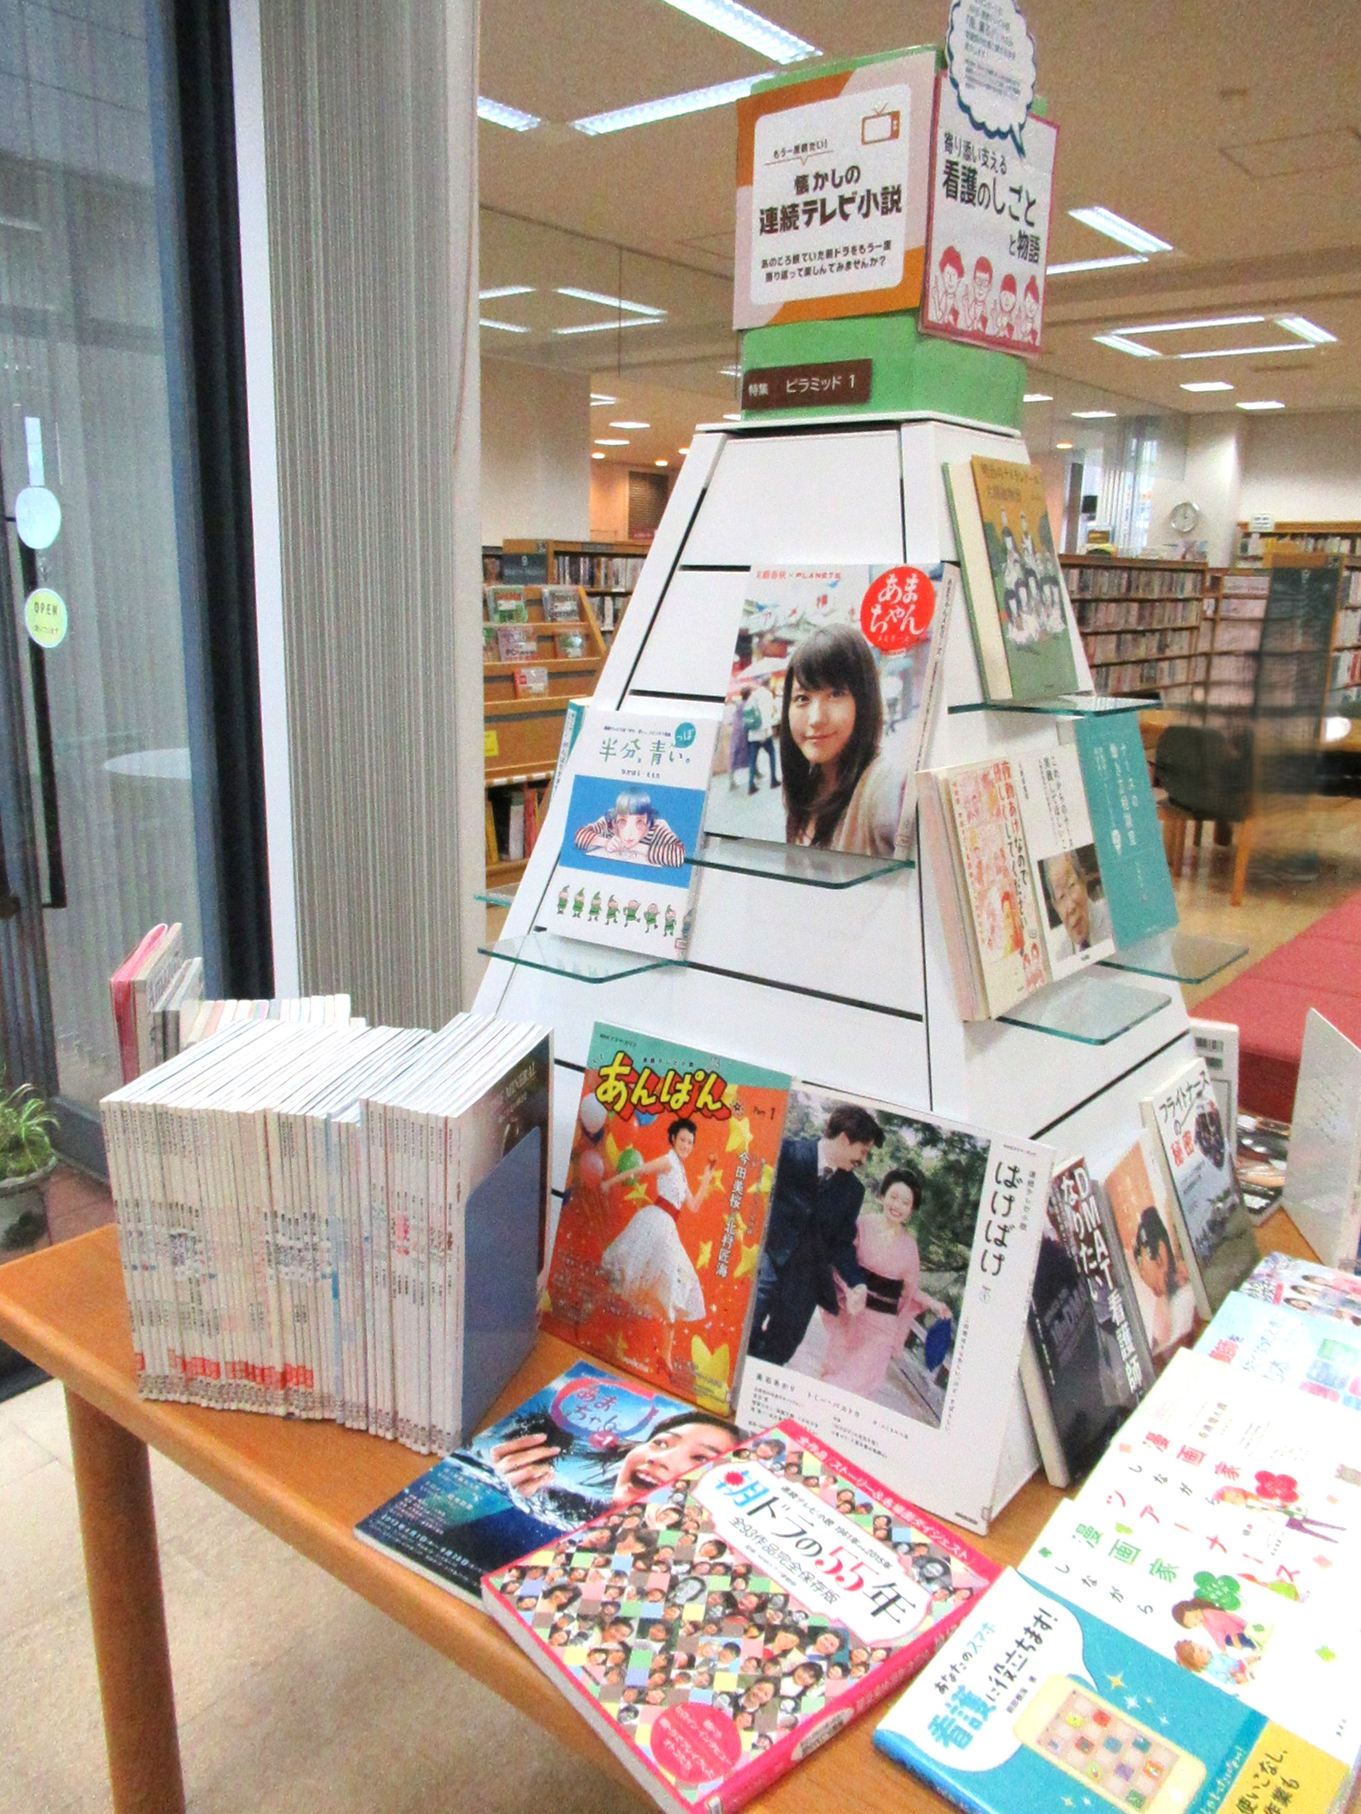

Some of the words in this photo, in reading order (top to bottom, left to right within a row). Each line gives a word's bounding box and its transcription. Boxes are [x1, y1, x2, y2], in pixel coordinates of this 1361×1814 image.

[794, 165, 861, 195] 懐かしの
[944, 132, 1007, 175] 寄り添い支える
[759, 183, 903, 236] 連続テレビ小説
[943, 159, 1037, 228] 看護のしごと
[1009, 229, 1041, 264] と物語
[786, 375, 843, 393] ピラミッド
[849, 374, 856, 388] 1
[34, 602, 58, 616] OPEN
[878, 574, 919, 606] あま
[870, 604, 926, 635] ちゃん
[599, 737, 691, 766] 半分、青い。
[595, 1051, 732, 1121] あんぱん
[1159, 1069, 1210, 1124] フライトナース
[980, 1161, 1024, 1277] ばけばけ
[1060, 1176, 1104, 1302] なりたい
[1142, 1431, 1241, 1482] 漫画家
[728, 1516, 841, 1607] 全93作品完全保存版
[1073, 1523, 1180, 1584] 漫画家
[1105, 1488, 1302, 1592] ツアーナース
[1053, 1563, 1156, 1617] しながら
[933, 1620, 997, 1695] あなたのスマホ
